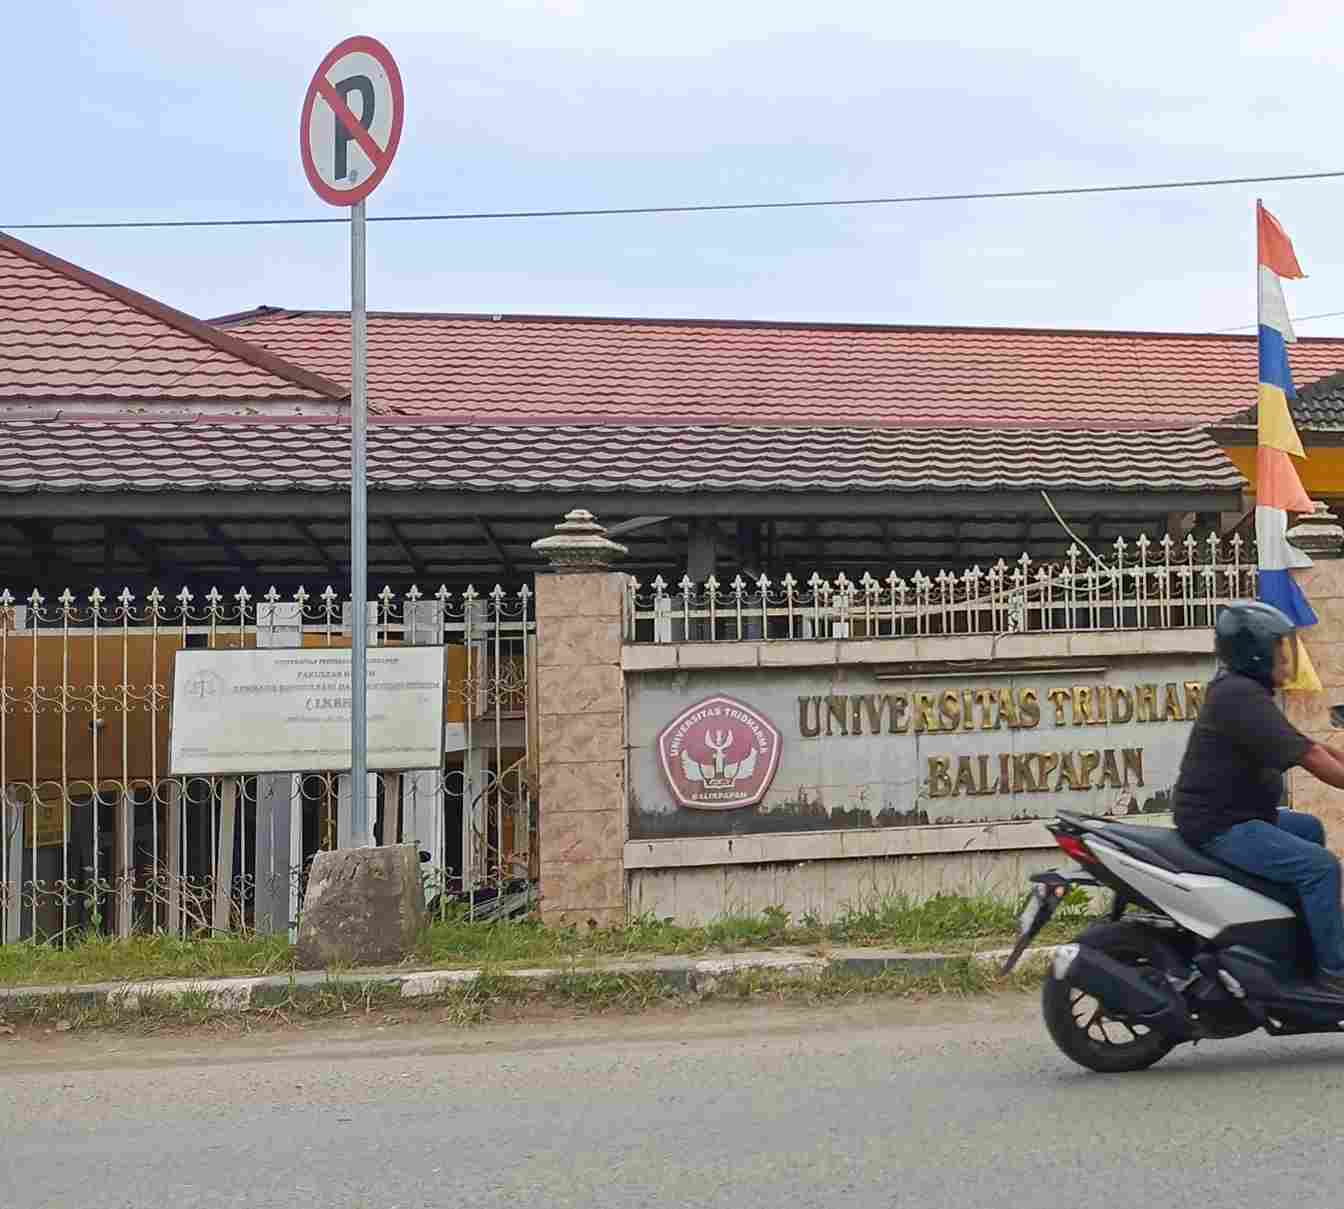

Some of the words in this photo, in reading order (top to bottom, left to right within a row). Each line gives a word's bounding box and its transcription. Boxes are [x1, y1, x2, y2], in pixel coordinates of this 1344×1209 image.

[334, 74, 376, 181] P
[670, 707, 721, 757] UNIVERSITAS
[724, 707, 769, 754] TRIDHARMA
[798, 687, 1040, 737] UNIVERSITAS
[1047, 681, 1201, 727] TRIDHAR
[691, 791, 748, 801] BALIKPAPAN
[928, 746, 1145, 798] BALIKPAPAN
